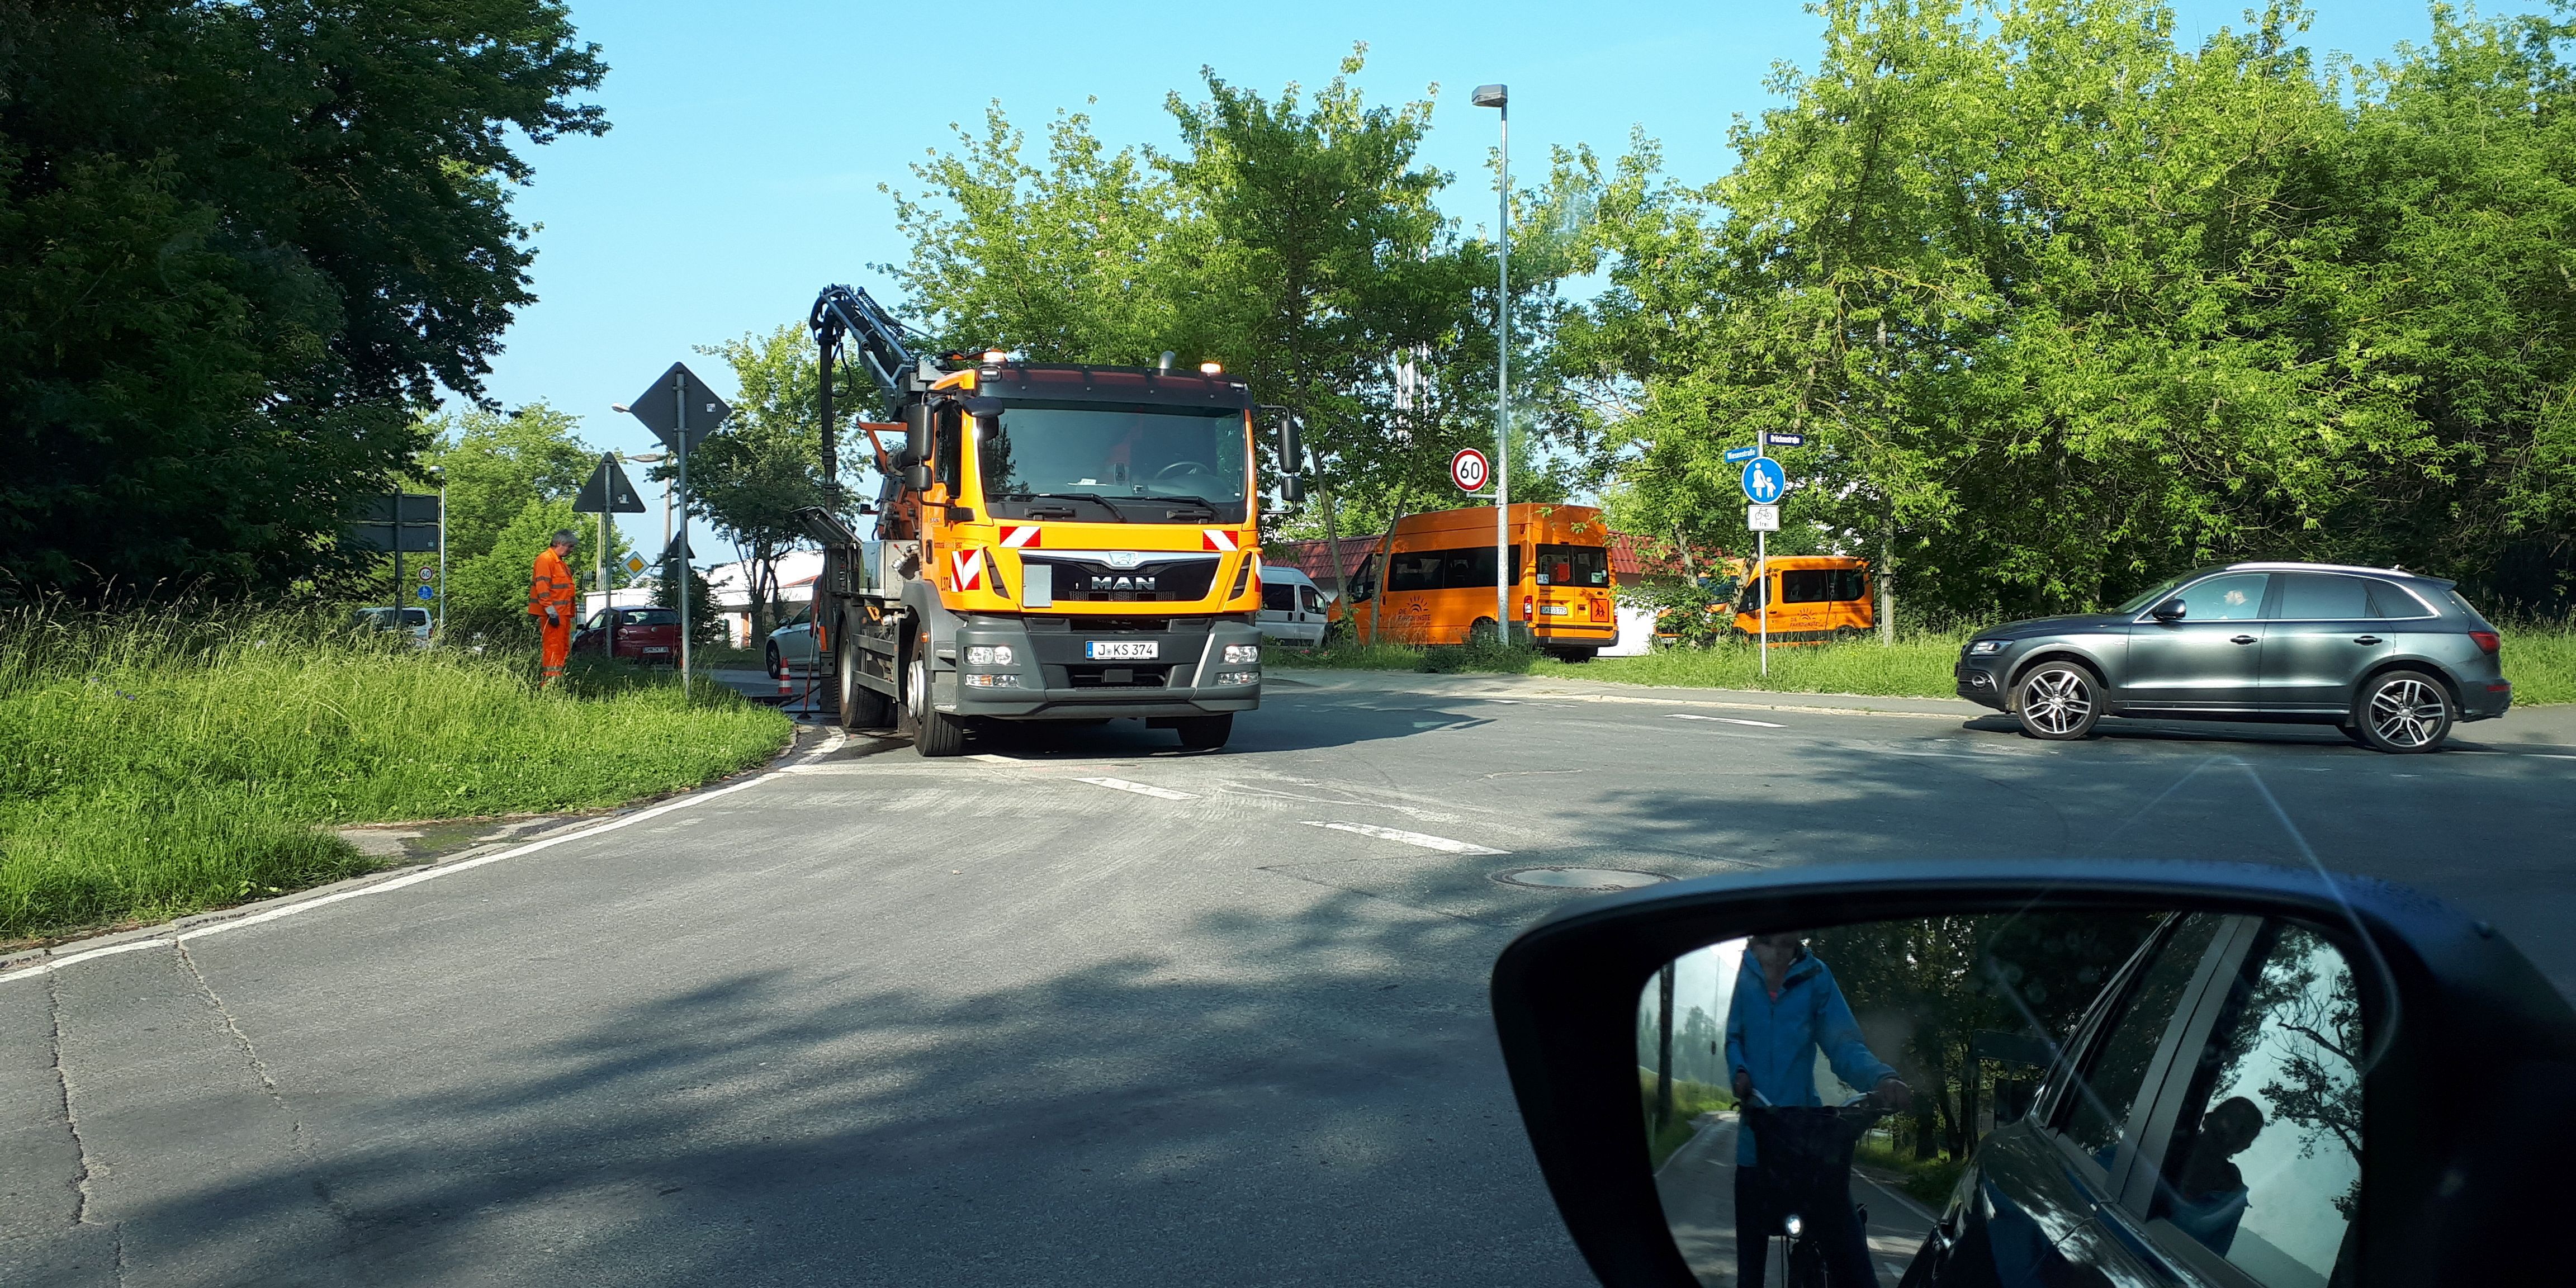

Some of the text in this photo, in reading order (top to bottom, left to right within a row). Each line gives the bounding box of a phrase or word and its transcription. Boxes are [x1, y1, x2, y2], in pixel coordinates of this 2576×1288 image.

[1460, 461, 1480, 480] 60
[1091, 576, 1156, 590] MAN
[1098, 645, 1153, 655] J KS 374
